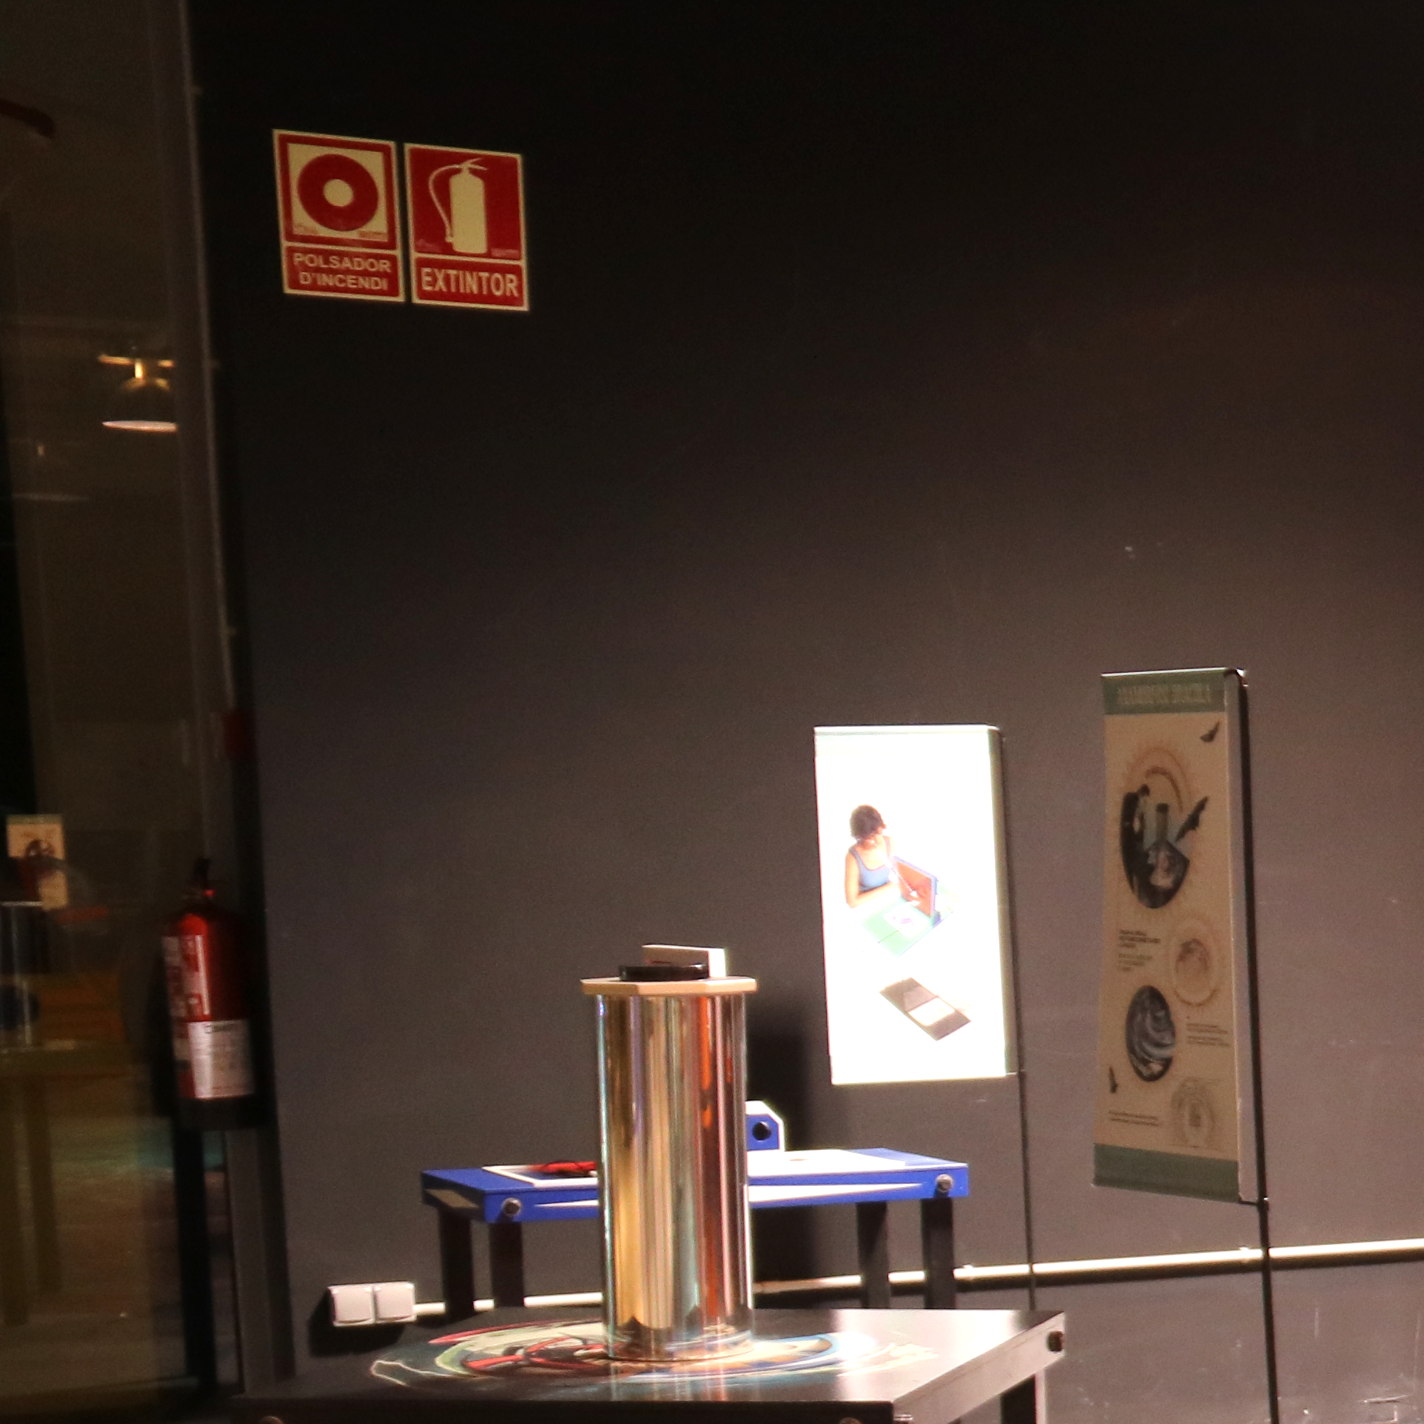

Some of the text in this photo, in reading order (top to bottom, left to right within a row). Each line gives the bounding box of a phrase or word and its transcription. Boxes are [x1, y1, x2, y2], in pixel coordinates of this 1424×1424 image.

[293, 252, 391, 273] POLSADOR
[299, 271, 388, 291] D'INCENDI
[421, 267, 519, 297] EXTINTOR
